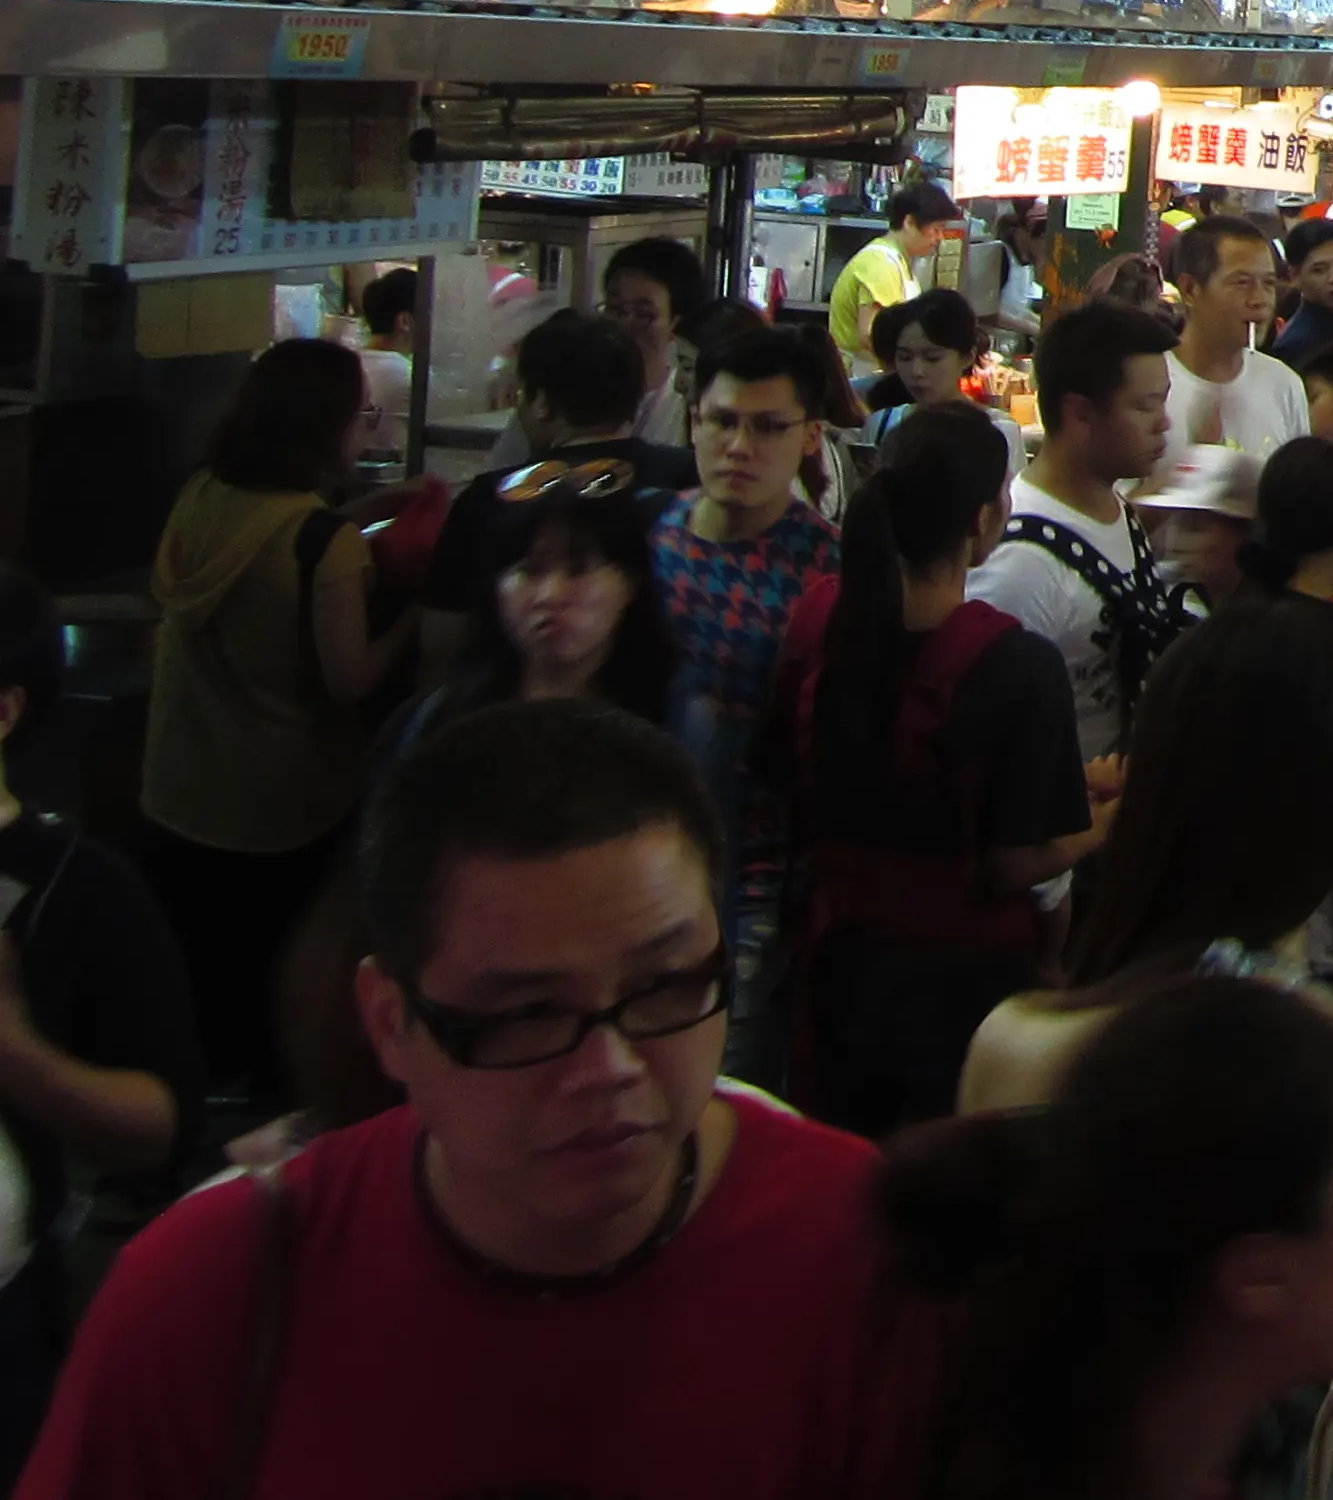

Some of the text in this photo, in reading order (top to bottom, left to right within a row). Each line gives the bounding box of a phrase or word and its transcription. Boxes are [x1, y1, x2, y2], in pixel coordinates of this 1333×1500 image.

[296, 33, 349, 59] 1950
[1168, 122, 1309, 174] 螃蟹羹 油飯
